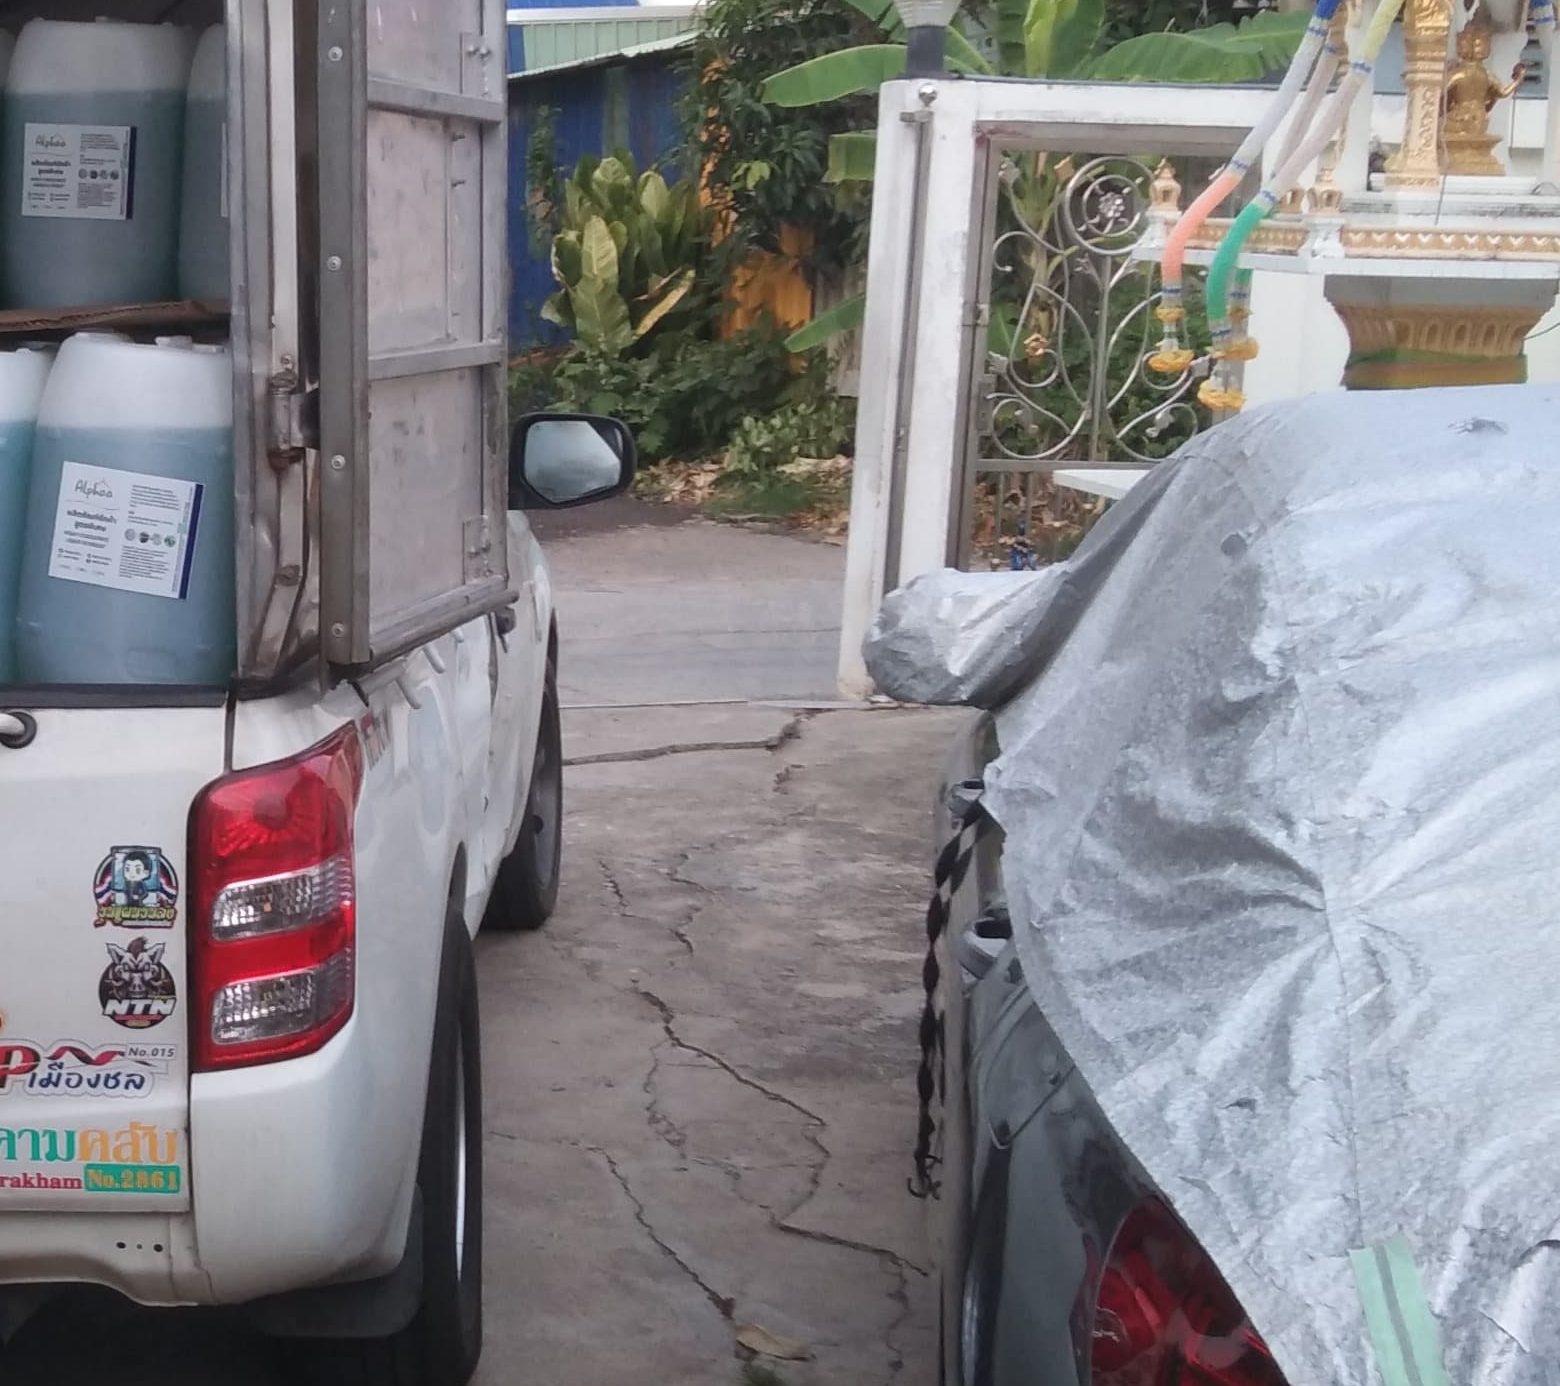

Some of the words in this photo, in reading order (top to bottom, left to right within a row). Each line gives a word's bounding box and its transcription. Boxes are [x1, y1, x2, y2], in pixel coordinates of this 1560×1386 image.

[104, 998, 177, 1016] NTN
[128, 1047, 176, 1059] No.015
[28, 1061, 147, 1092] เมืองชล
[87, 1168, 179, 1191] No.2861
